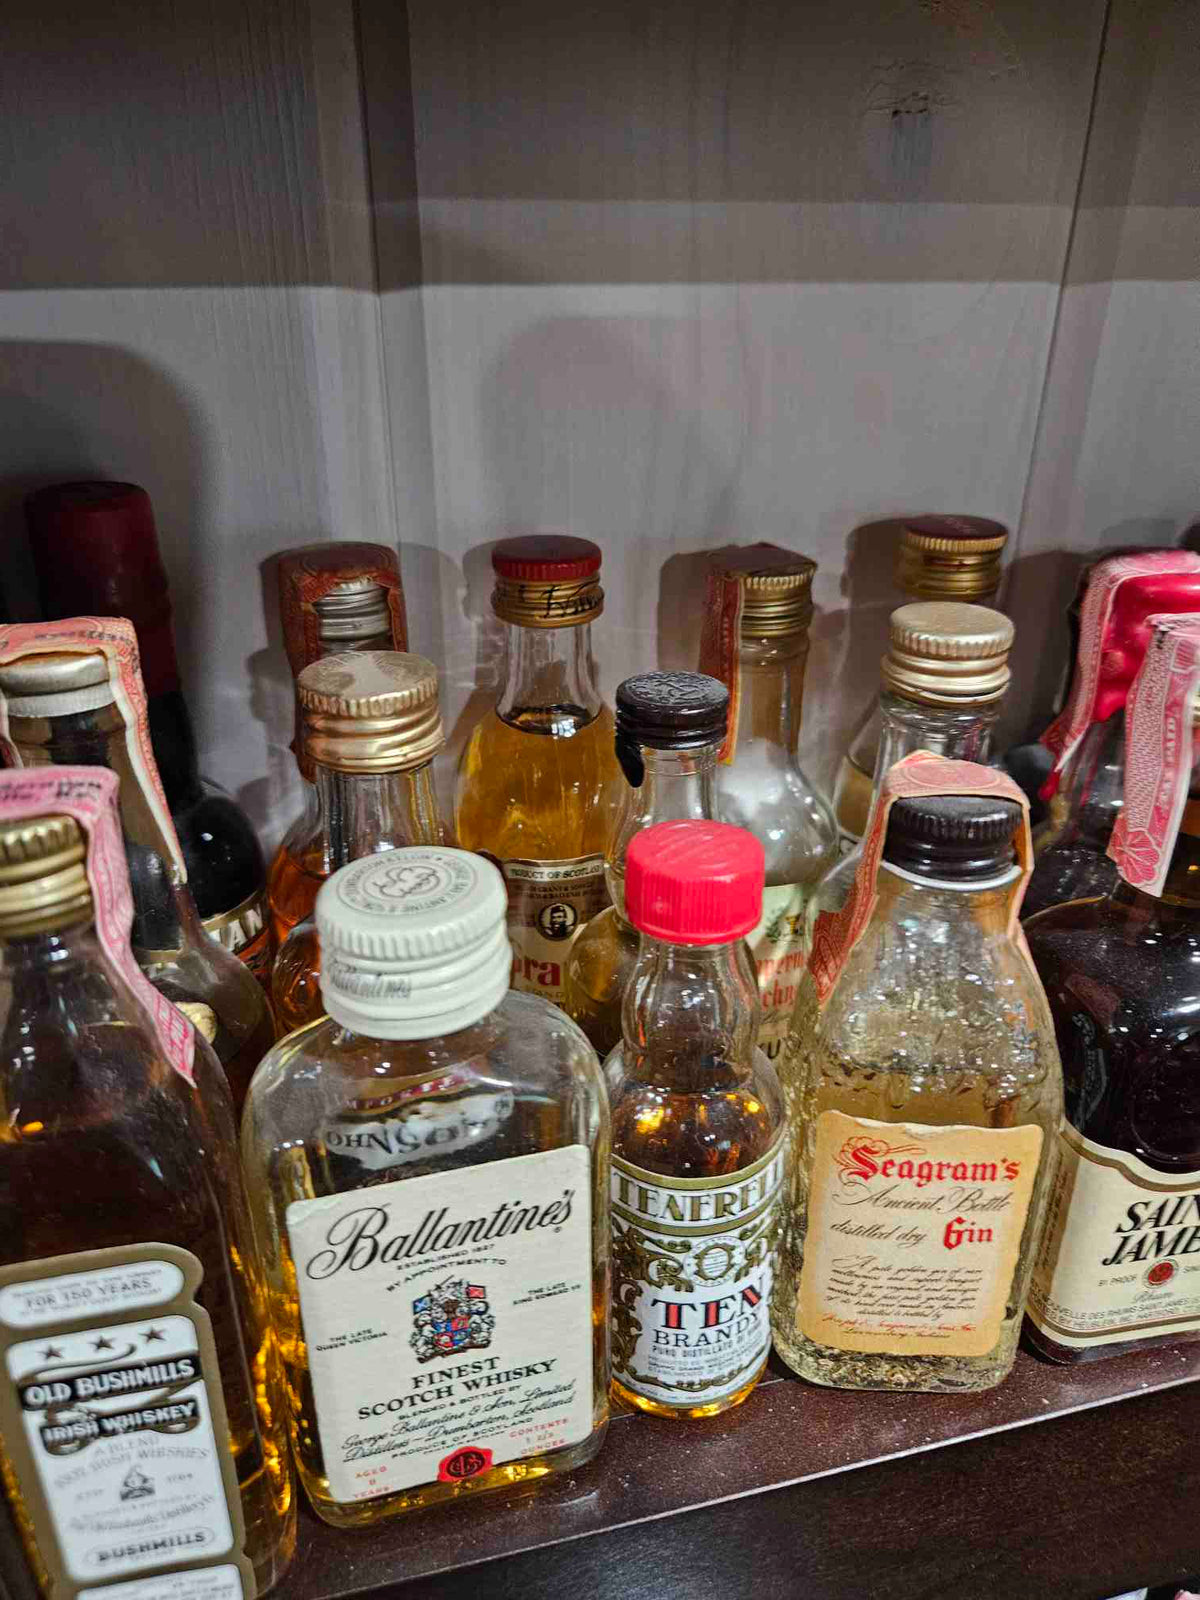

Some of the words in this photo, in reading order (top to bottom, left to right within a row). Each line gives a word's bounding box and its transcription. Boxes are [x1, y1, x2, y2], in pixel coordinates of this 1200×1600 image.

[547, 870, 561, 879] OF
[834, 1138, 1022, 1188] Seagram's
[832, 1184, 940, 1211] Ancient
[941, 1186, 1014, 1214] Bottle
[306, 1189, 576, 1280] Ballantine's
[830, 1219, 897, 1240] distilled
[896, 1226, 928, 1248] dry
[943, 1216, 993, 1250] Gin
[386, 1282, 401, 1292] BY
[404, 1258, 489, 1283] APPOINTMENT
[491, 1258, 507, 1266] TO
[397, 1249, 468, 1270] ESTABLISHED
[98, 1278, 152, 1296] YEARS
[651, 1273, 765, 1330] TEN
[348, 1332, 388, 1345] VICTORIA
[350, 1328, 372, 1338] LATE
[652, 1311, 760, 1348] BRANDY
[24, 1382, 72, 1407] OLD
[75, 1359, 196, 1397] BUSHMILLS
[358, 1385, 454, 1420] SCOTCH
[461, 1358, 558, 1392] WHISKY
[411, 1356, 500, 1390] FINEST
[341, 1433, 388, 1449] George
[389, 1411, 467, 1438] Ballantine
[518, 1378, 577, 1403] Limited
[398, 1403, 447, 1420] BLENDED
[459, 1388, 506, 1404] BOTTLED
[508, 1384, 522, 1392] BY
[513, 1390, 577, 1418] Scotland
[42, 1420, 99, 1444] IRISH
[101, 1402, 196, 1435] WHISKEY
[391, 1440, 447, 1459] PRODUCE
[452, 1433, 467, 1442] OF
[472, 1417, 533, 1437] SCOTLAND
[509, 1417, 569, 1438] CONTENTS
[355, 1465, 388, 1479] AGED
[98, 1531, 206, 1562] BUSHMILLS
